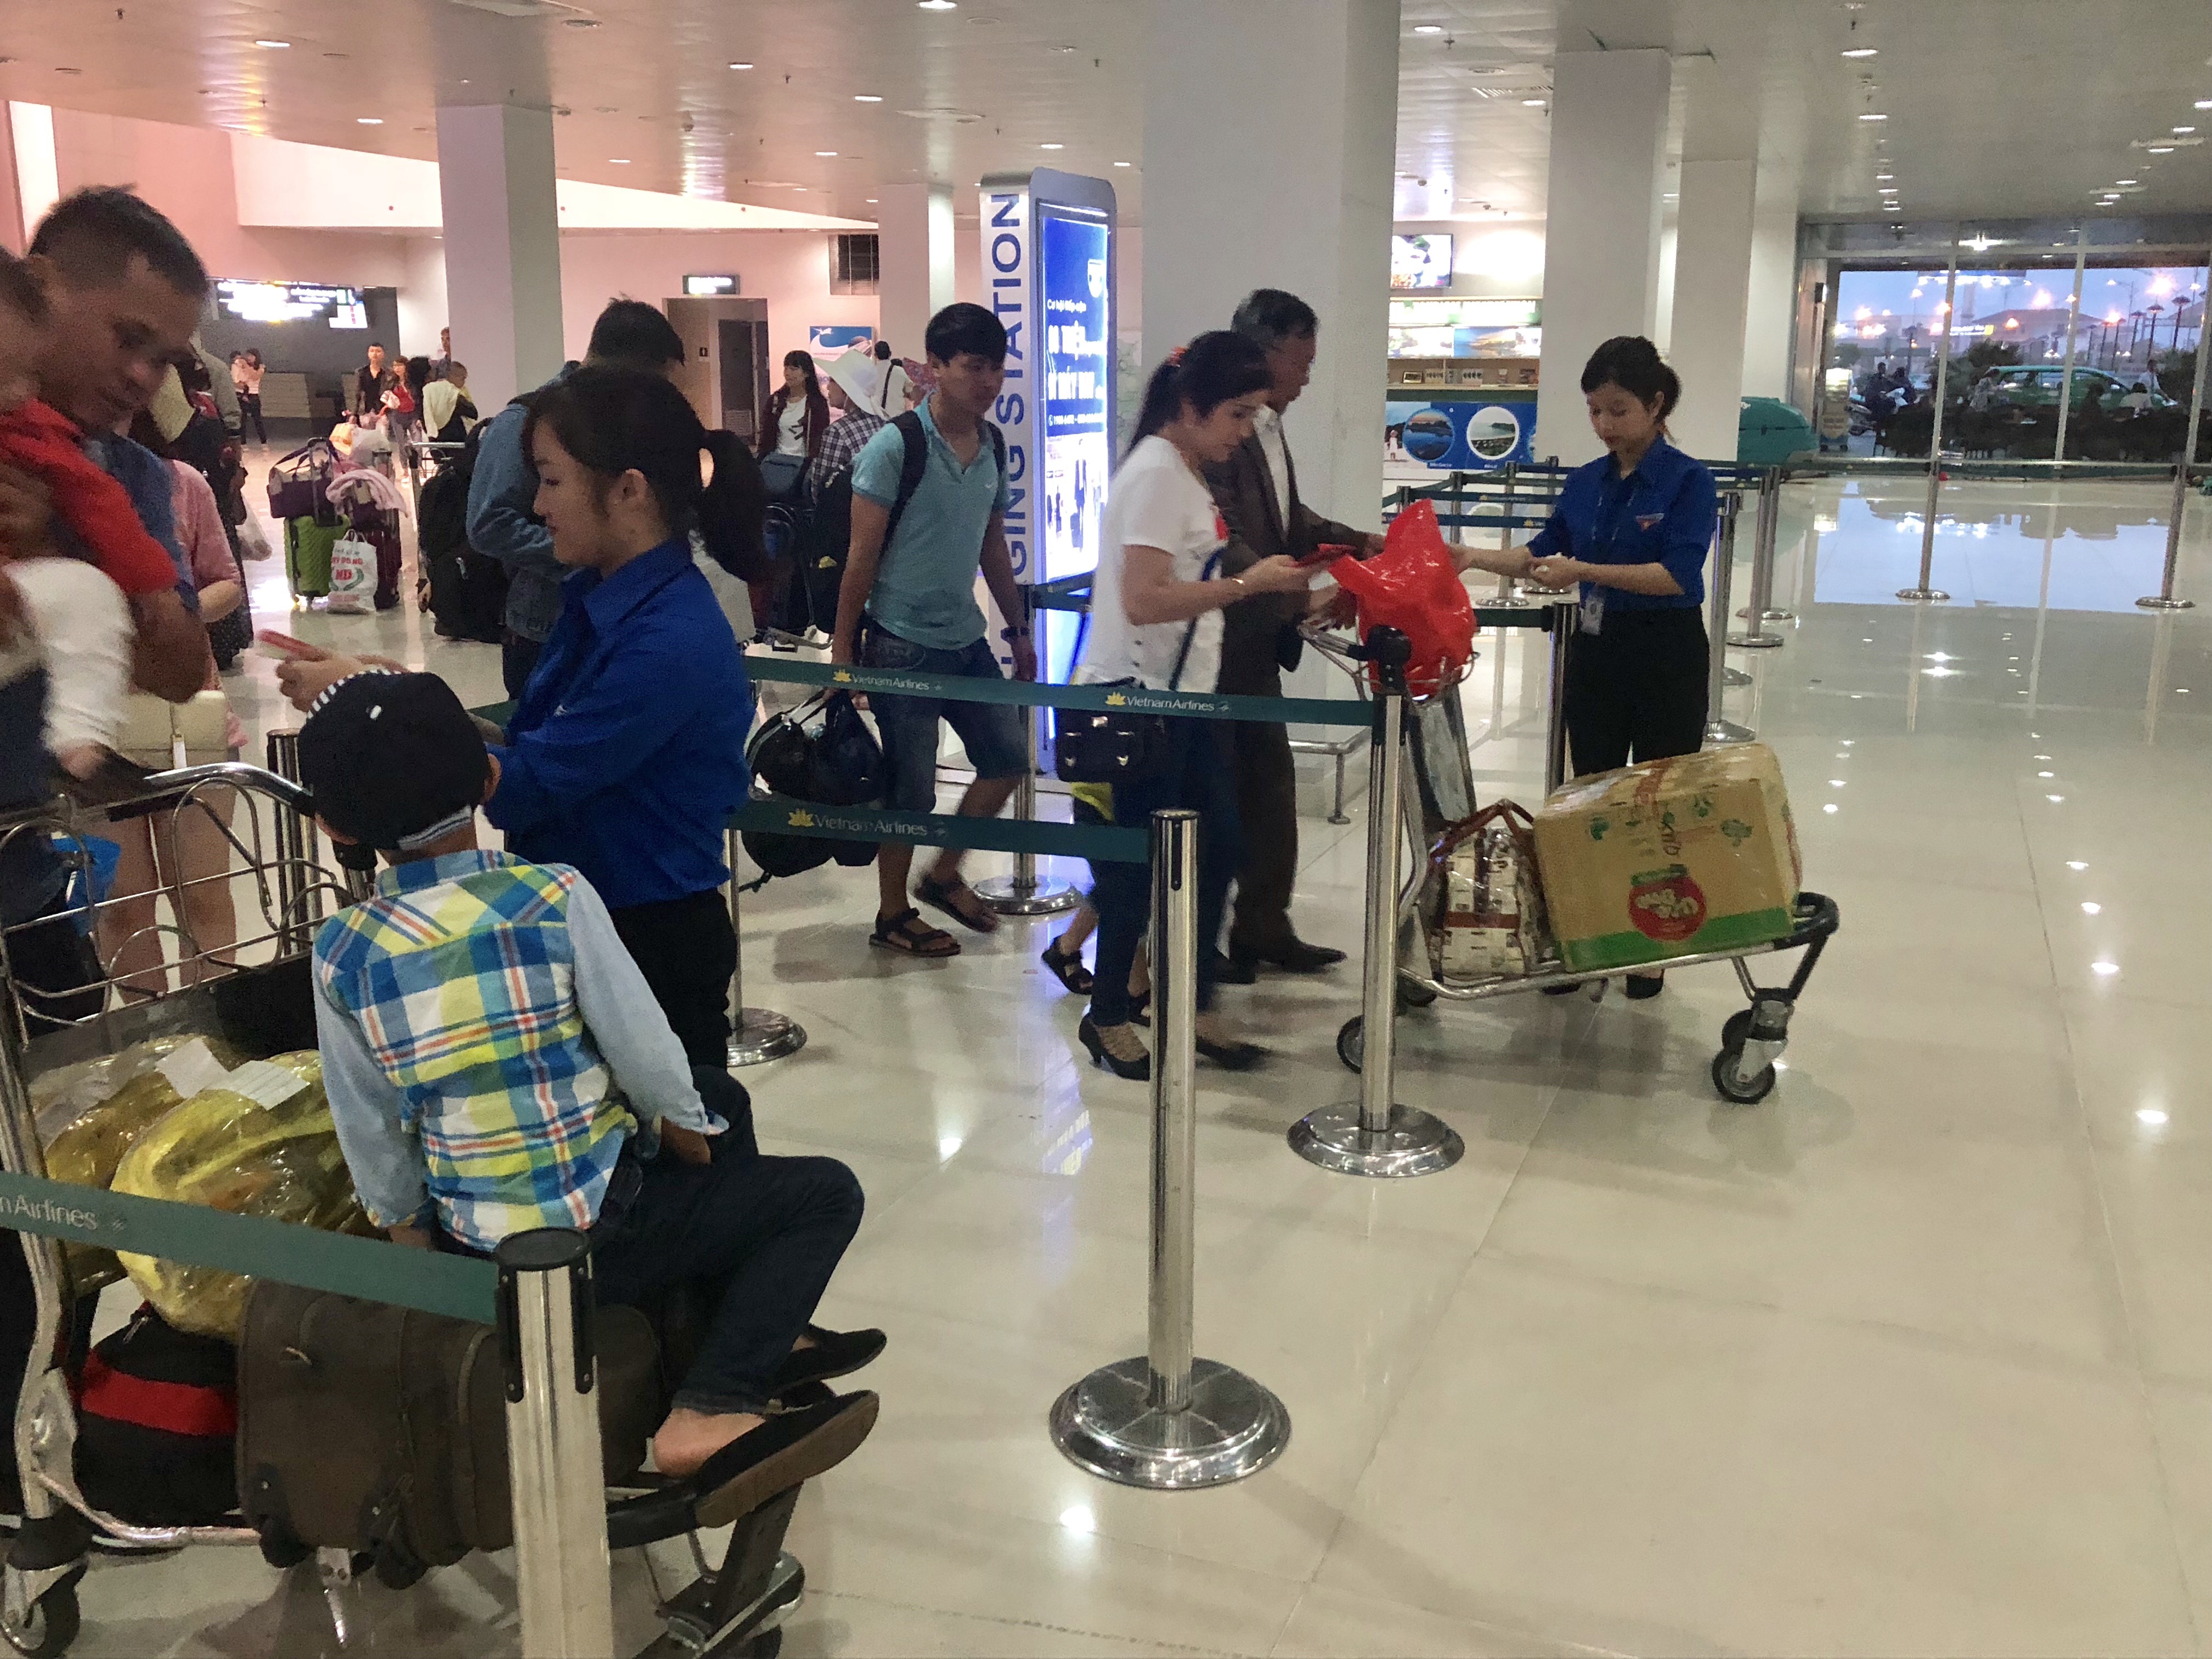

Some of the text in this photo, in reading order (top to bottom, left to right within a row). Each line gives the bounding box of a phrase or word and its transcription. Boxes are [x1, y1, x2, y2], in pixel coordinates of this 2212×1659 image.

[852, 673, 929, 691] Vietnam Airlines
[1126, 696, 1215, 712] Vietnam Airlines
[874, 819, 928, 836] Airlines
[14, 1194, 98, 1230] Airlines
